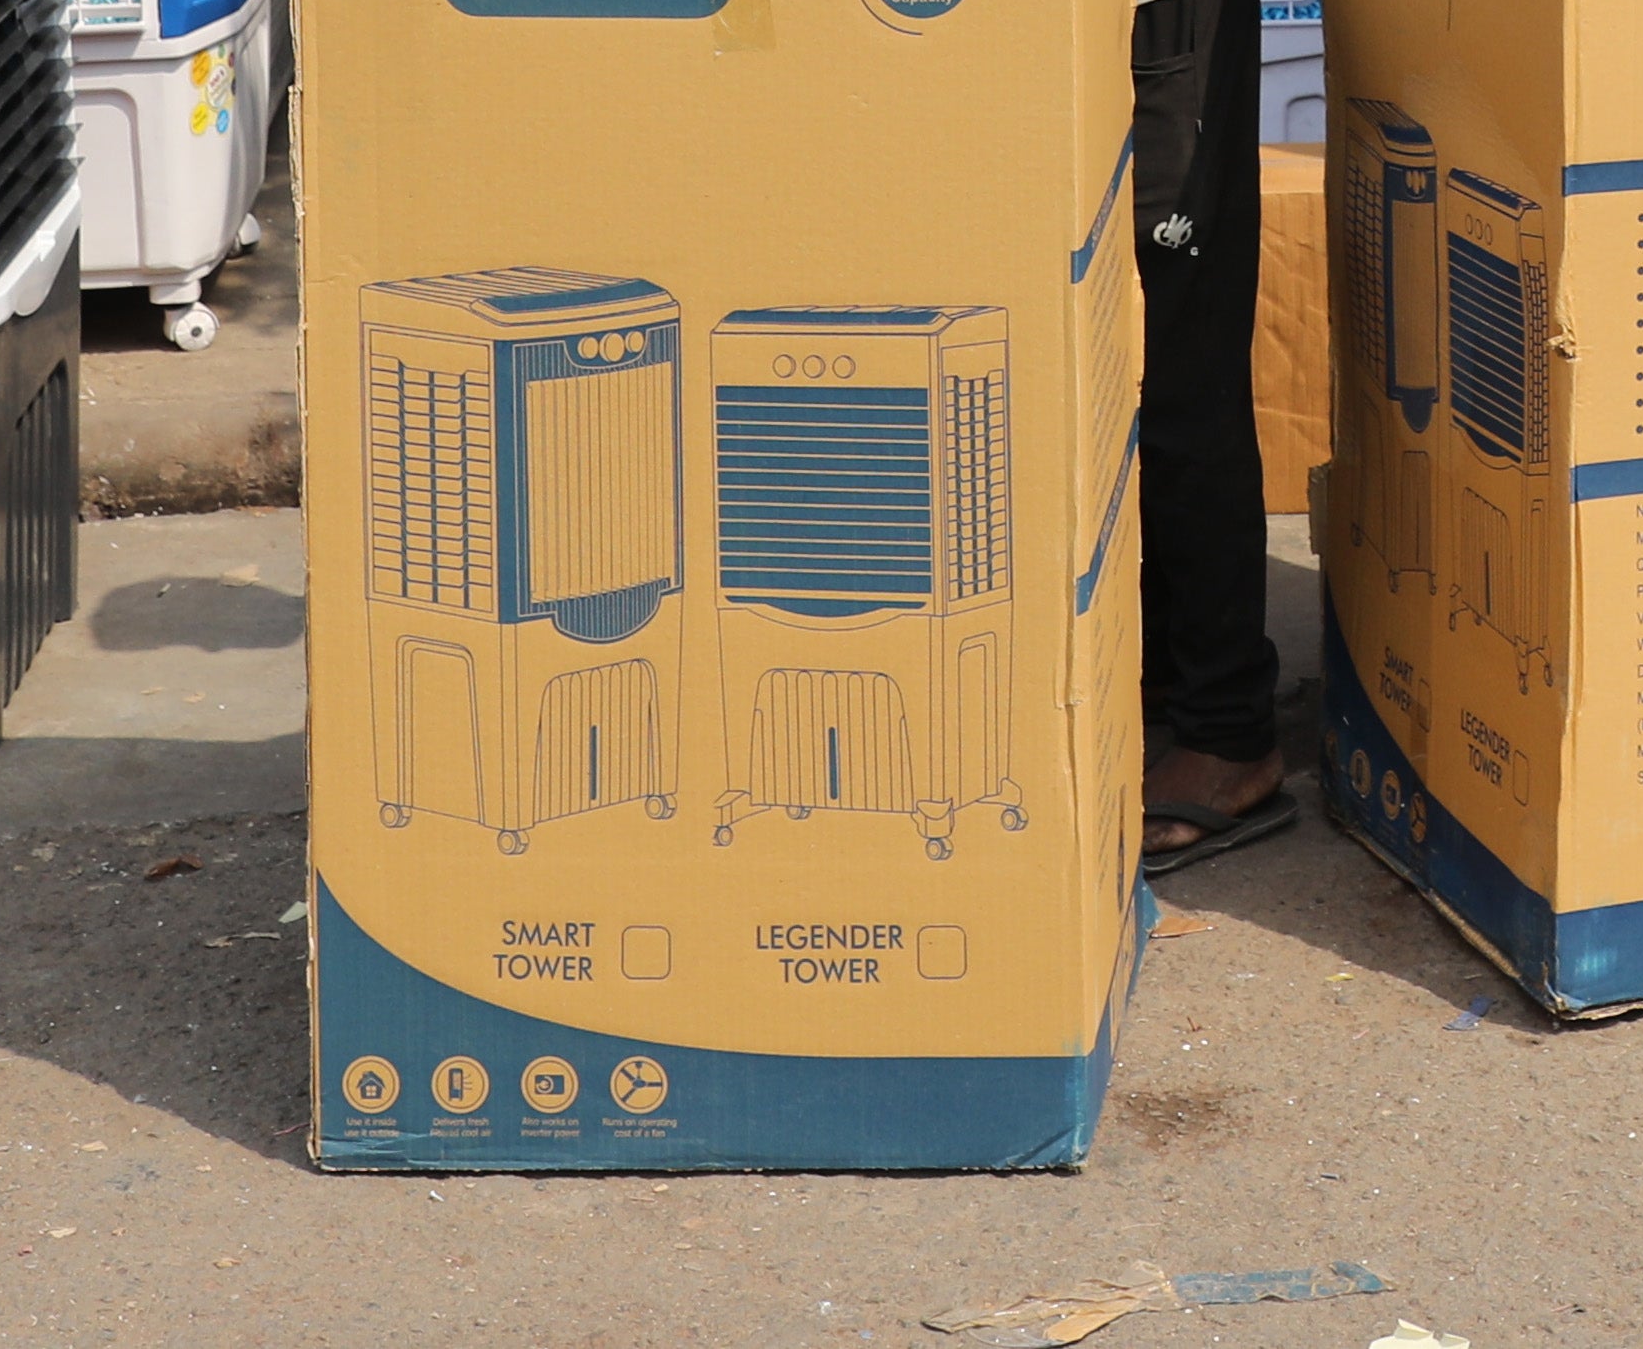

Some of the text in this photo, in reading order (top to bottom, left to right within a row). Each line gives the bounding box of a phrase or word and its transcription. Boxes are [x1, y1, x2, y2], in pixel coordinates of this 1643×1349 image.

[1461, 709, 1511, 762] LEGENDER
[1468, 744, 1502, 787] TOWER
[502, 921, 596, 948] SMART
[755, 924, 904, 951] LEGENDER
[492, 955, 594, 983] TOWER
[779, 958, 880, 985] TOWER
